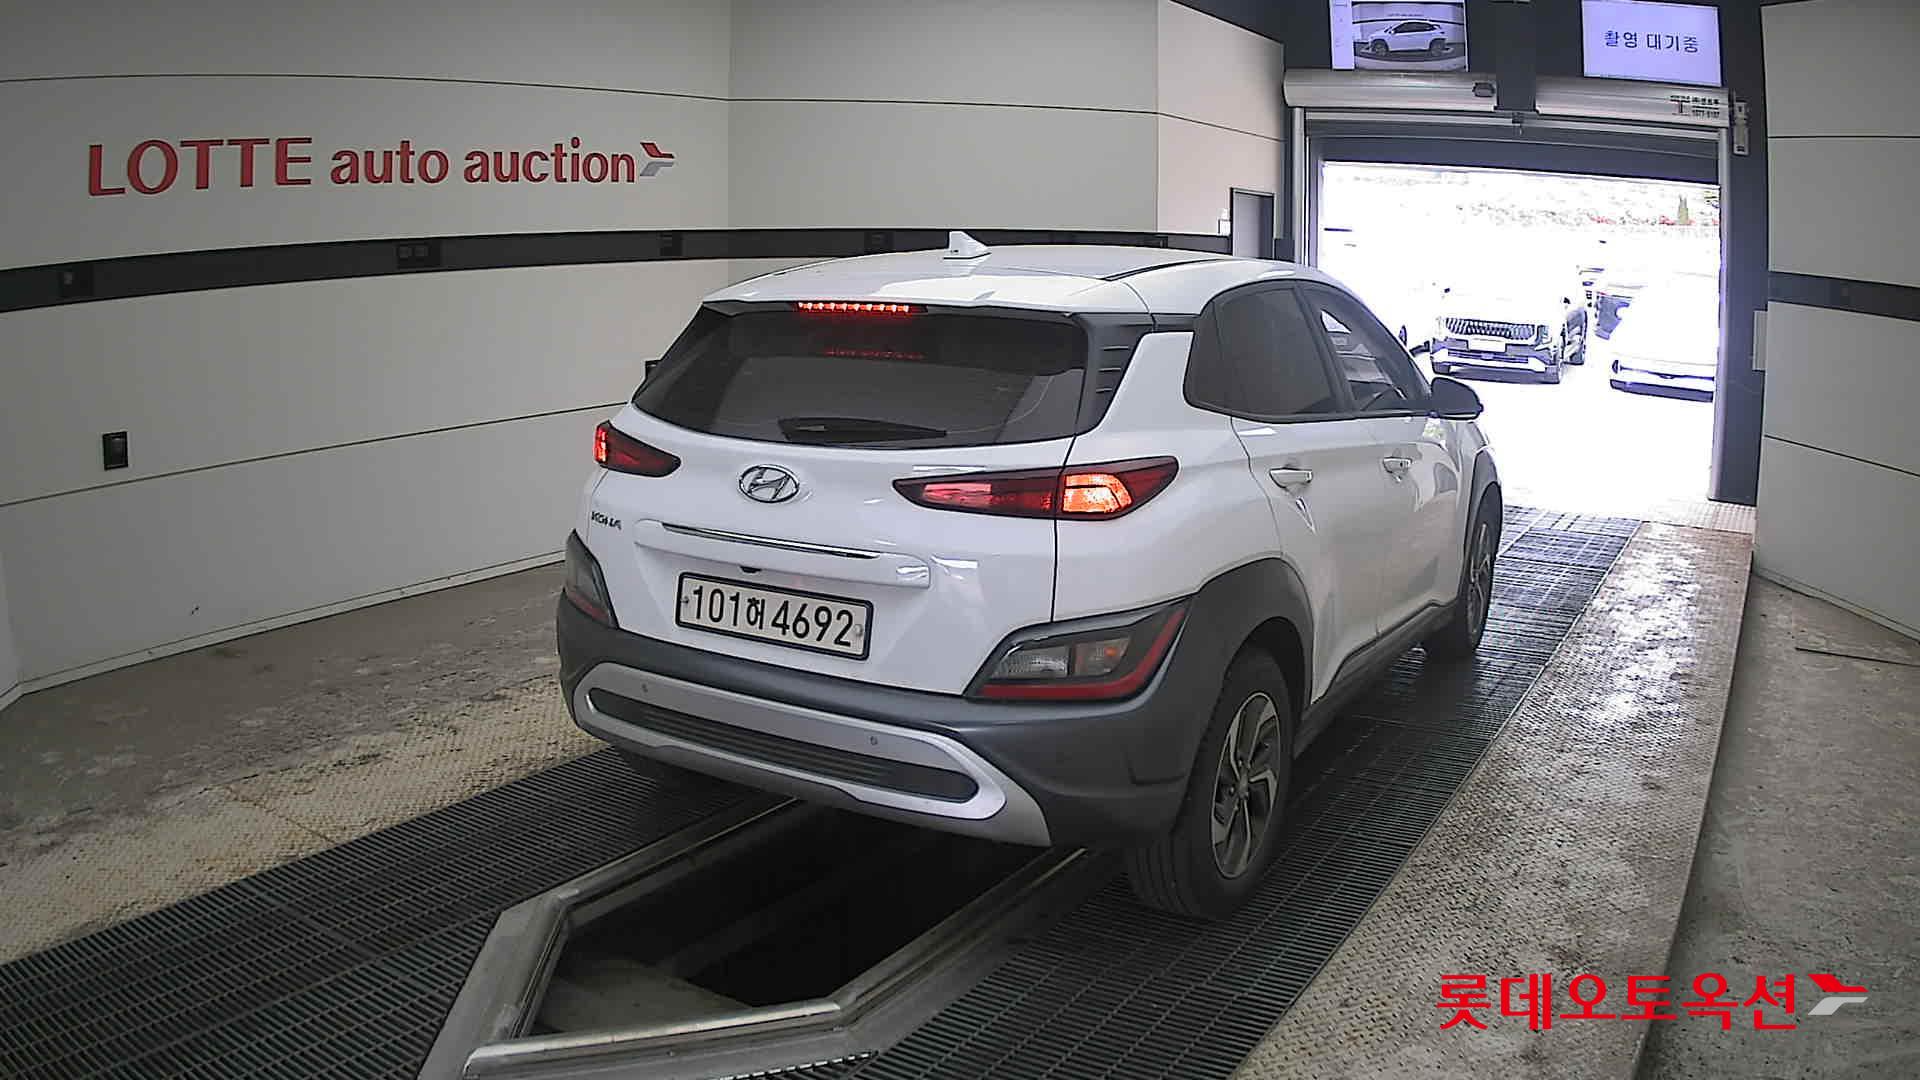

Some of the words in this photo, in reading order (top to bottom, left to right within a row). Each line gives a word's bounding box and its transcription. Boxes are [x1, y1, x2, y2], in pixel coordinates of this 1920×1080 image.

[1646, 33, 1698, 53] 대기중
[89, 138, 312, 196] LOTTE
[330, 141, 450, 185] auto
[463, 137, 637, 183] auction
